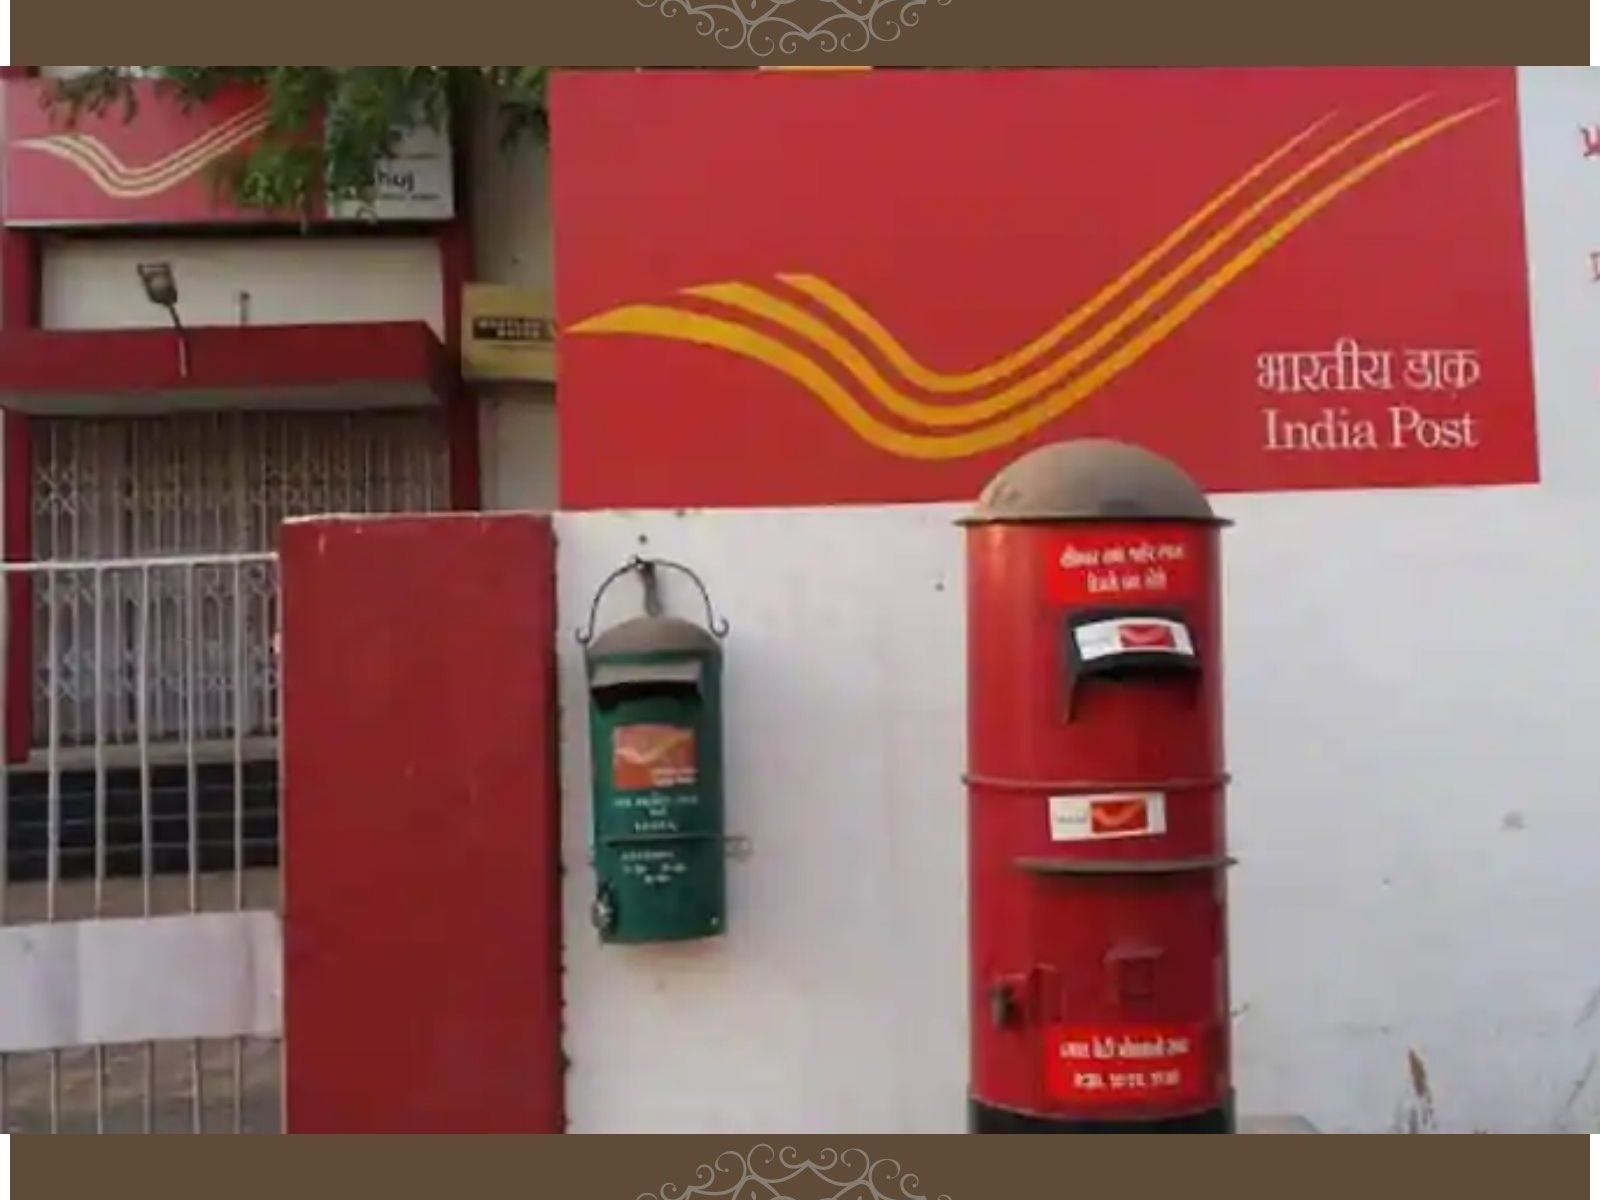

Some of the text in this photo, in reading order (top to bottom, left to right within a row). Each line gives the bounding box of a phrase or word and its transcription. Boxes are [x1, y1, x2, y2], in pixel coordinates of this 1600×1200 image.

[1256, 336, 1481, 393] भारतीय डाक
[1262, 404, 1479, 450] India Post
